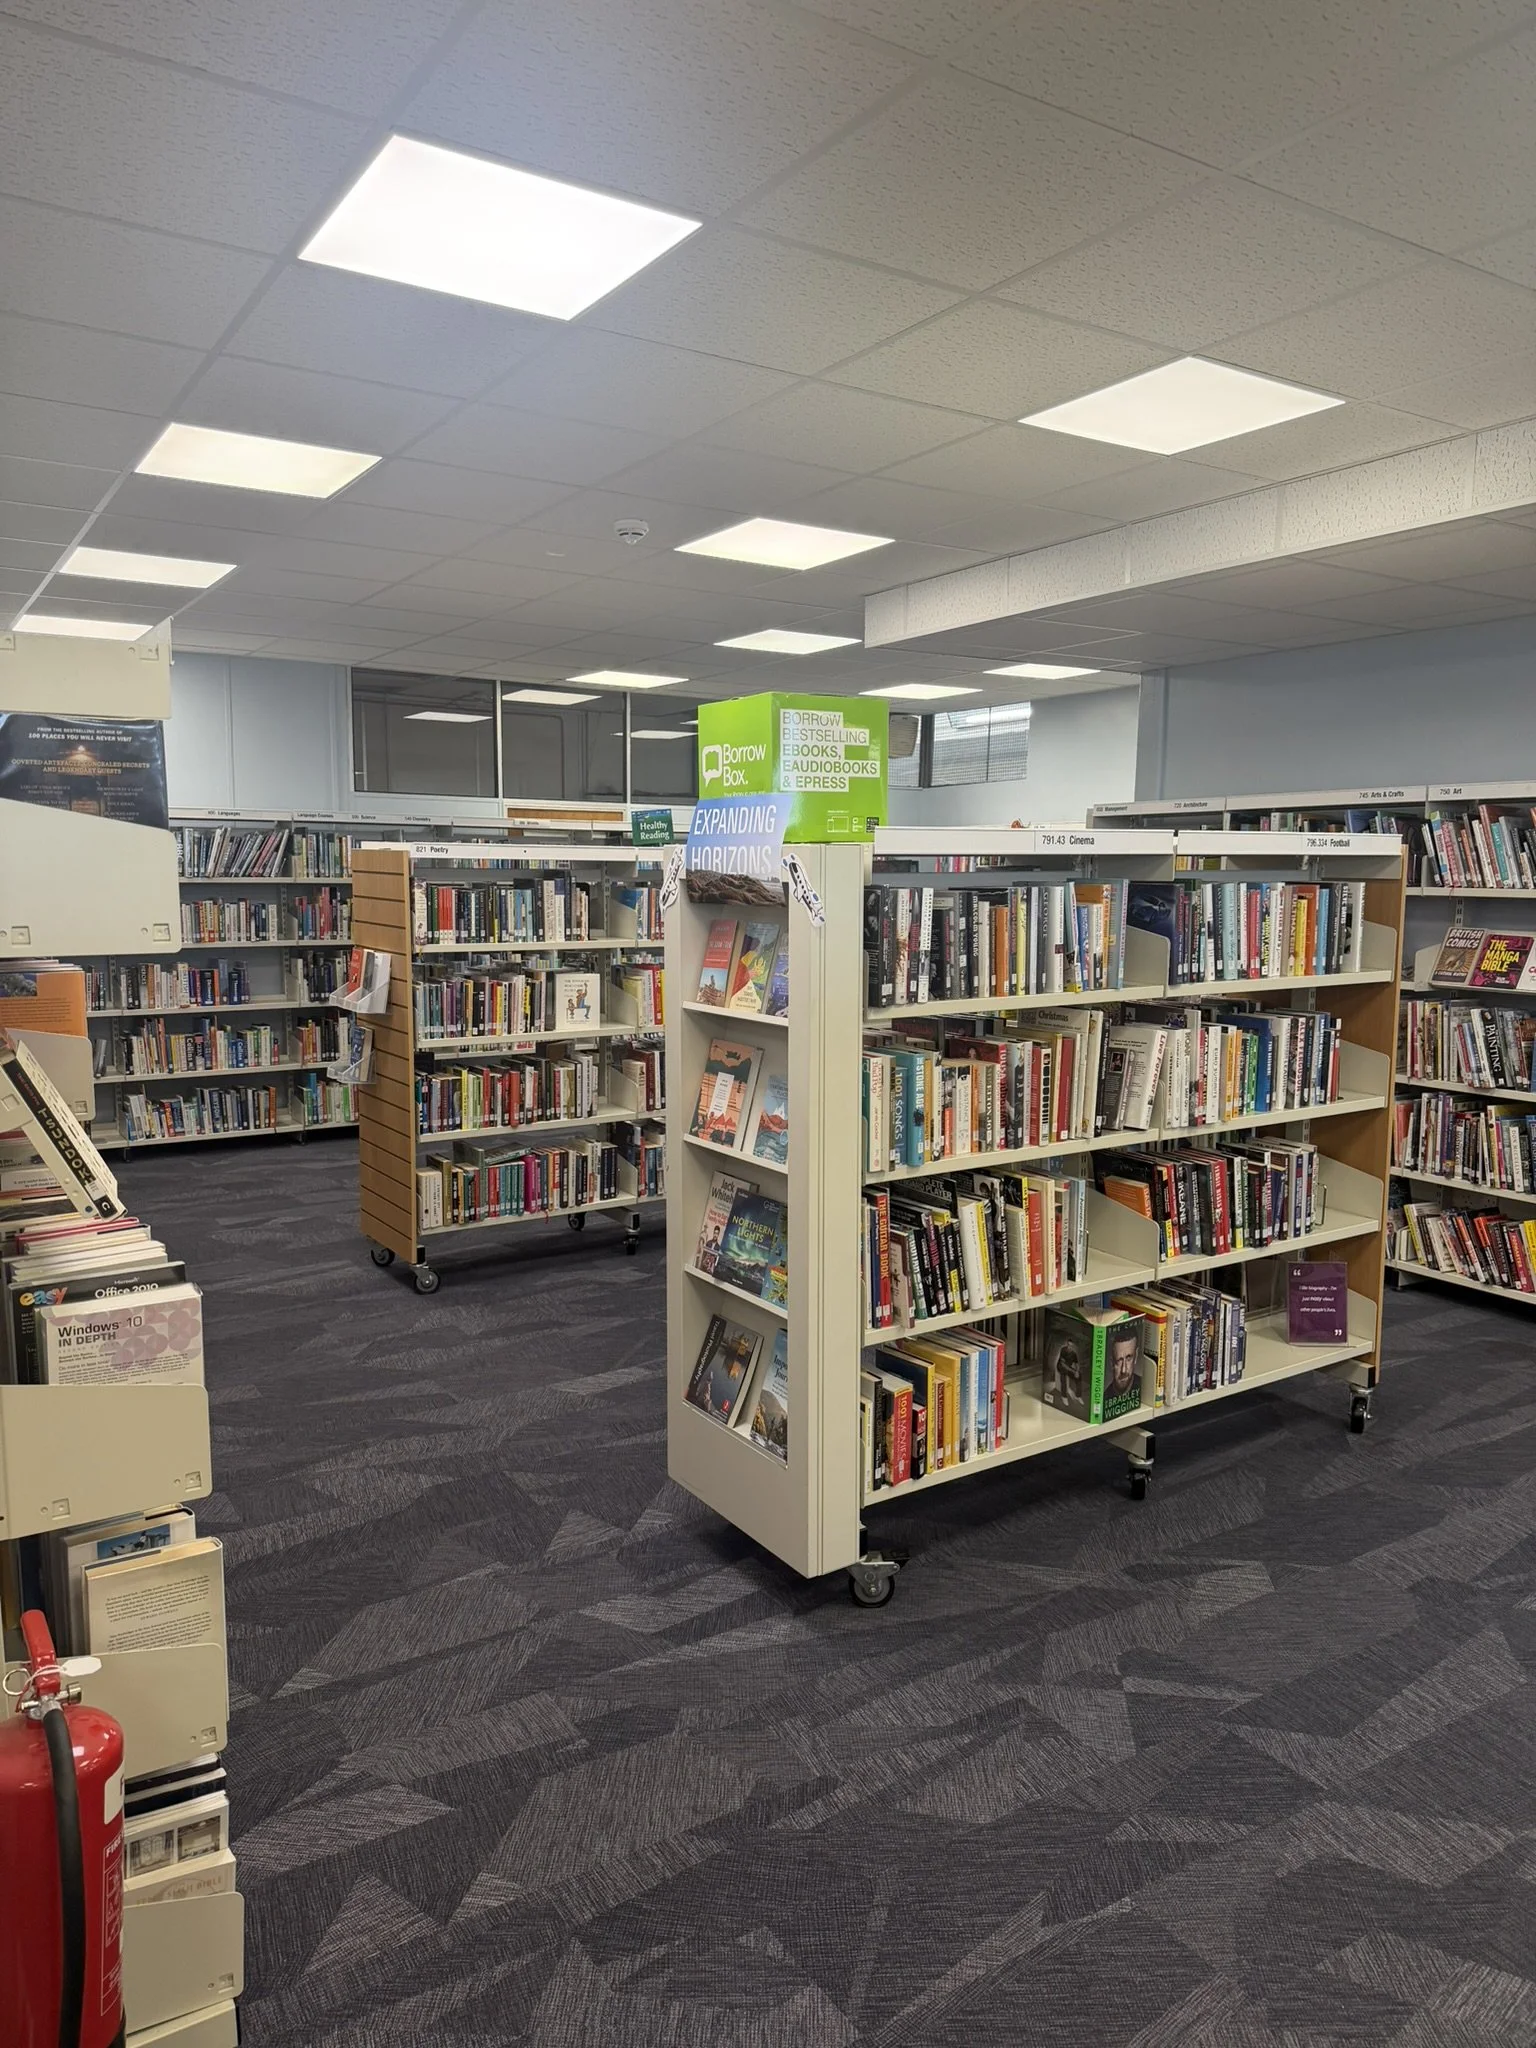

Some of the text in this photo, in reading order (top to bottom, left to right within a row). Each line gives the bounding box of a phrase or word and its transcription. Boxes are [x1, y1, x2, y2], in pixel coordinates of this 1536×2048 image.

[783, 712, 841, 726] BORROW
[783, 728, 867, 745] BESTSELLING
[723, 743, 766, 764] Borrow
[783, 744, 842, 760] EBOOKS,
[783, 760, 877, 775] EAUDIOBOOKS
[783, 776, 847, 790] & EPRESS
[1453, 787, 1462, 795] Art
[1388, 790, 1405, 798] Crafts
[640, 821, 668, 832] Healthy
[694, 804, 777, 835] EXPANDING
[640, 830, 670, 840] Reading
[1042, 835, 1095, 846] 791.43 Cinema
[1306, 838, 1351, 848] 796.334 Football
[415, 845, 449, 855] 821 Poetry
[691, 845, 772, 875] HORIZONS
[1341, 885, 1349, 905] STEVE
[1449, 929, 1483, 939] BRITISH
[1445, 938, 1480, 949] COMICS
[1490, 940, 1509, 949] THE
[1485, 950, 1520, 963] MANGA
[1480, 960, 1511, 972] BIBLE
[1038, 1010, 1069, 1022] Christmas
[1485, 1024, 1501, 1072] PAINTING
[1150, 1034, 1167, 1095] Live Forever
[1296, 1046, 1304, 1093] FERGUSON
[916, 1065, 924, 1109] STONE AGE
[895, 1072, 903, 1140] 1001 SONGS
[721, 1178, 735, 1192] Jack
[1178, 1185, 1188, 1225] KEANE
[732, 1215, 774, 1236] NORTHERN
[737, 1228, 764, 1243] LIGHTS
[879, 1199, 889, 1279] THE GUITAR BOOK
[947, 1235, 955, 1260] Ukulele
[114, 1276, 140, 1285] Microsoft
[19, 1286, 68, 1306] easy
[95, 1282, 159, 1299] Office 2010
[58, 1315, 143, 1338] Windows 10
[58, 1331, 117, 1348] IN DEPTH
[1095, 1335, 1103, 1369] BRADLEY
[1109, 1388, 1140, 1406] BRADLEY
[1105, 1397, 1140, 1420] WIGGINS
